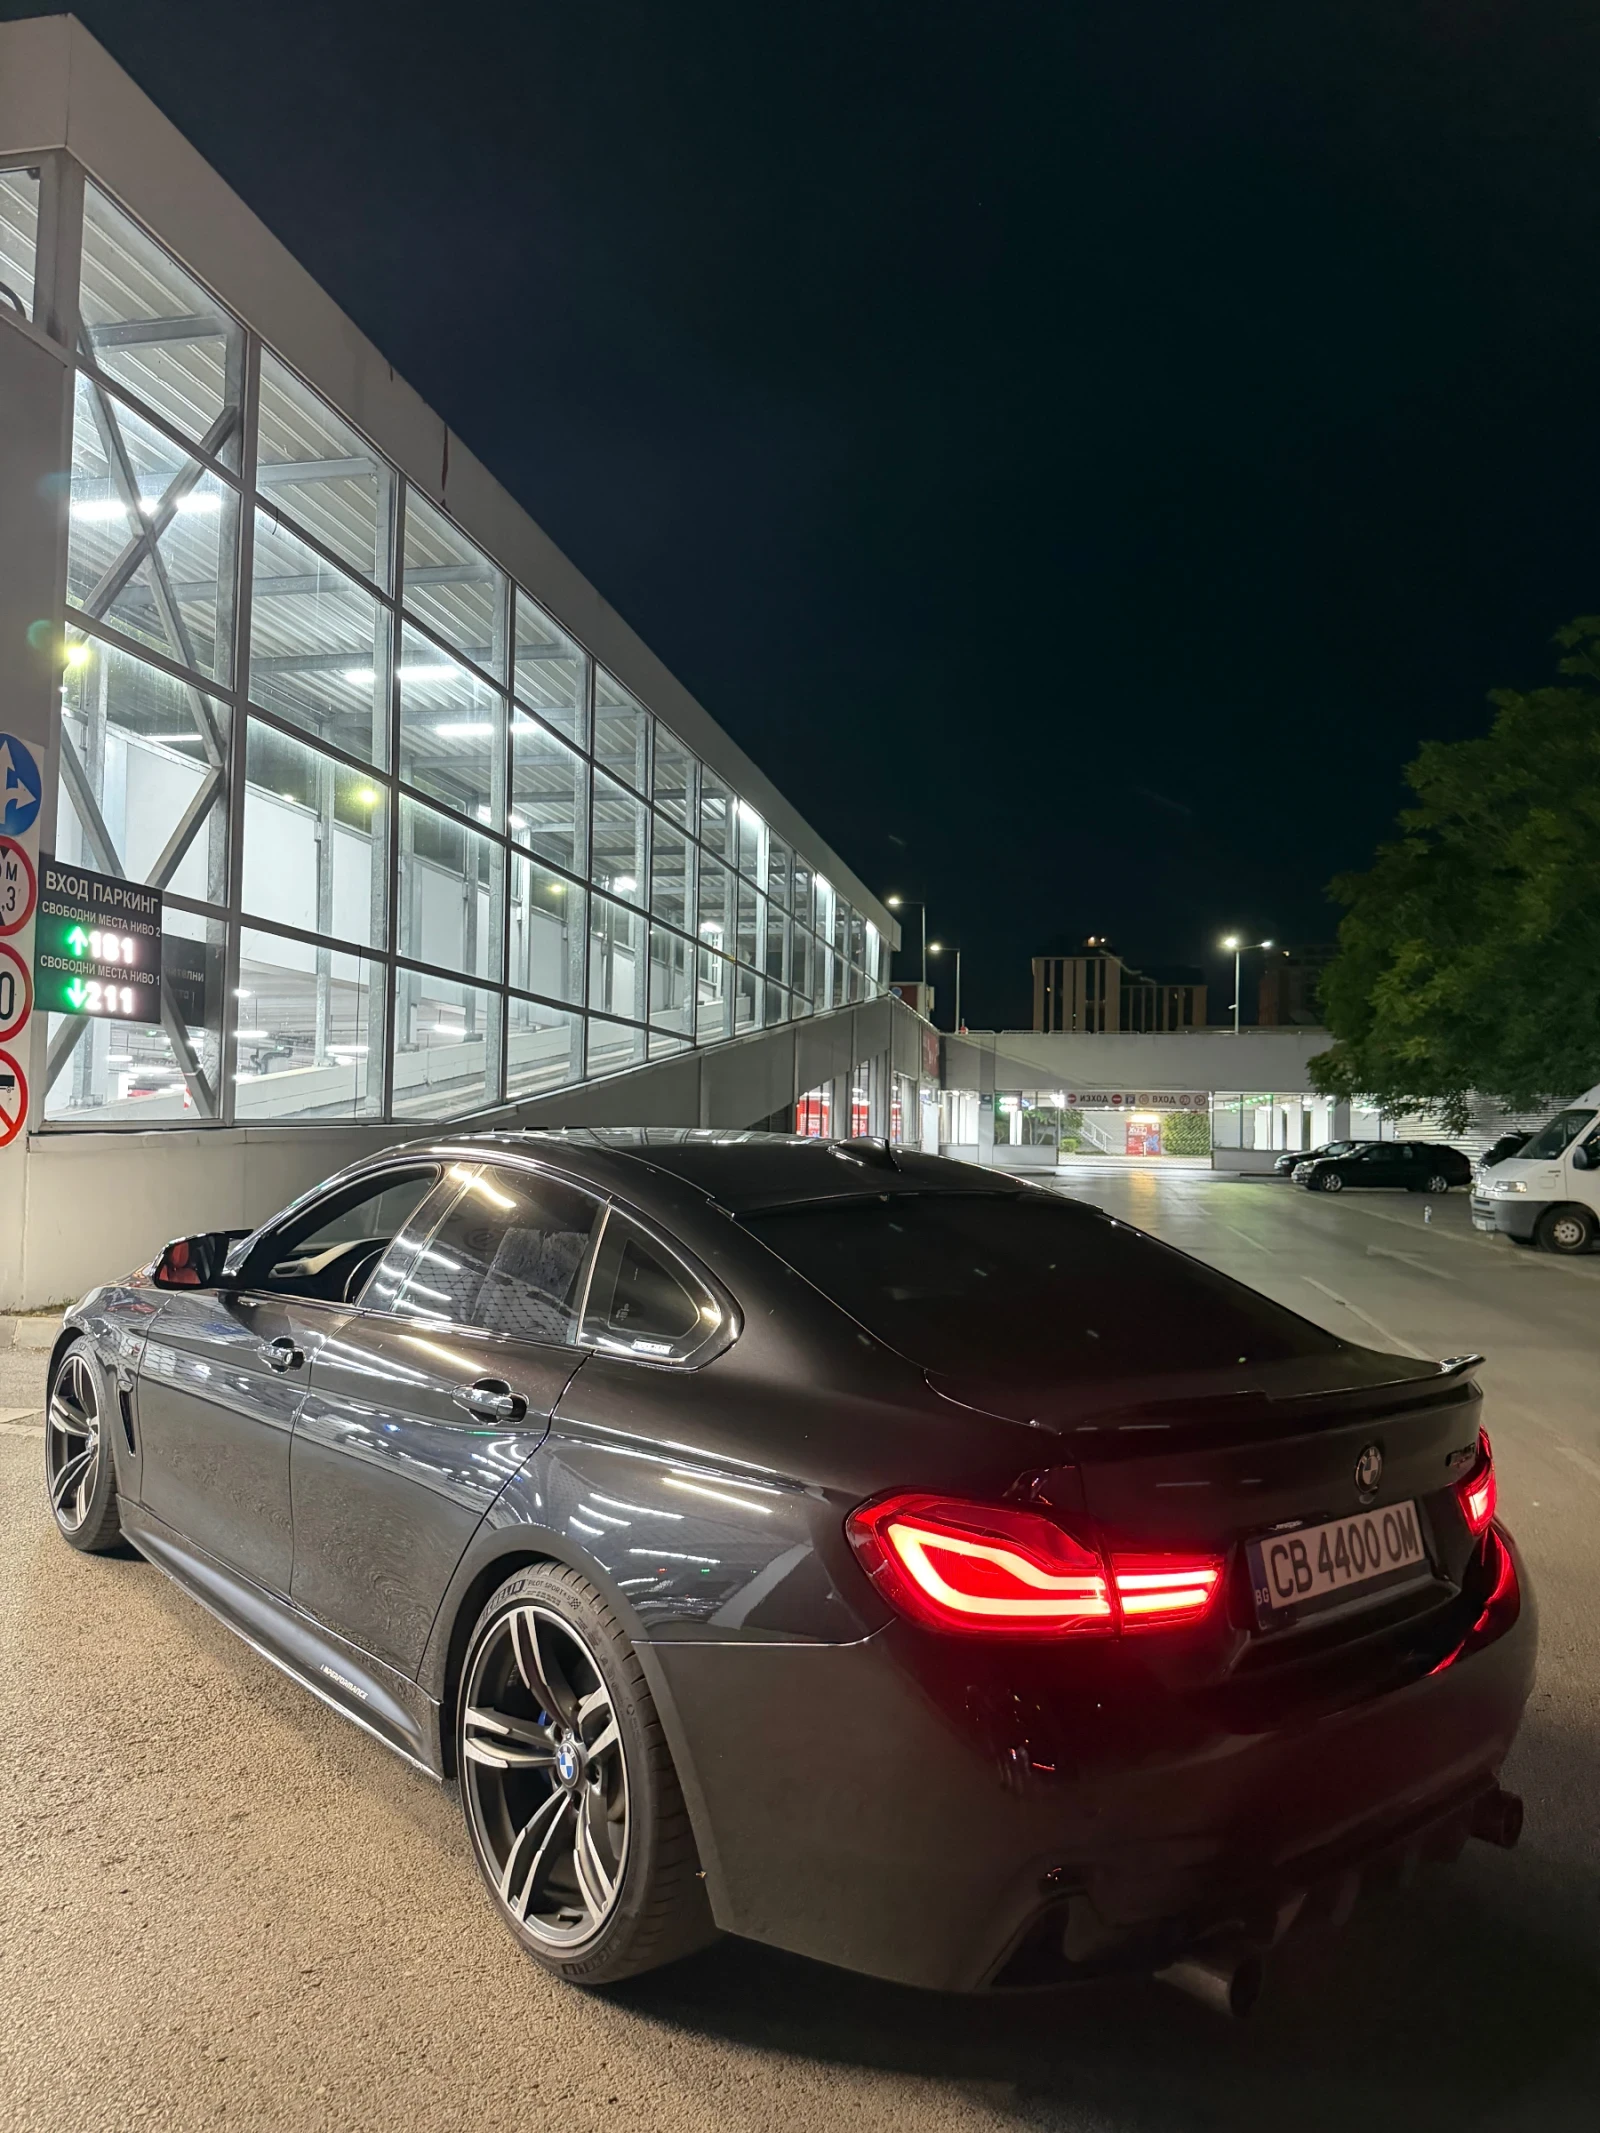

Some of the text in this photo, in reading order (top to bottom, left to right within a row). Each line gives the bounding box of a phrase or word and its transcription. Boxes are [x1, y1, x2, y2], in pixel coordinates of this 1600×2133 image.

[1, 885, 16, 912] ,3
[45, 870, 159, 915] ВХОД ПАРКИНГ
[42, 901, 161, 938] СВОБОДНИ МЕСТА НИВО 2
[40, 954, 160, 986] СВОБОДНИ МЕСТА НИВО 1
[0, 971, 15, 1021] 0
[85, 981, 132, 1014] 211
[1080, 1094, 1108, 1103] ИЗХОД
[1152, 1095, 1176, 1104] ВХОД
[1270, 1507, 1420, 1598] CB 4400 OM
[1255, 1588, 1270, 1605] BG
